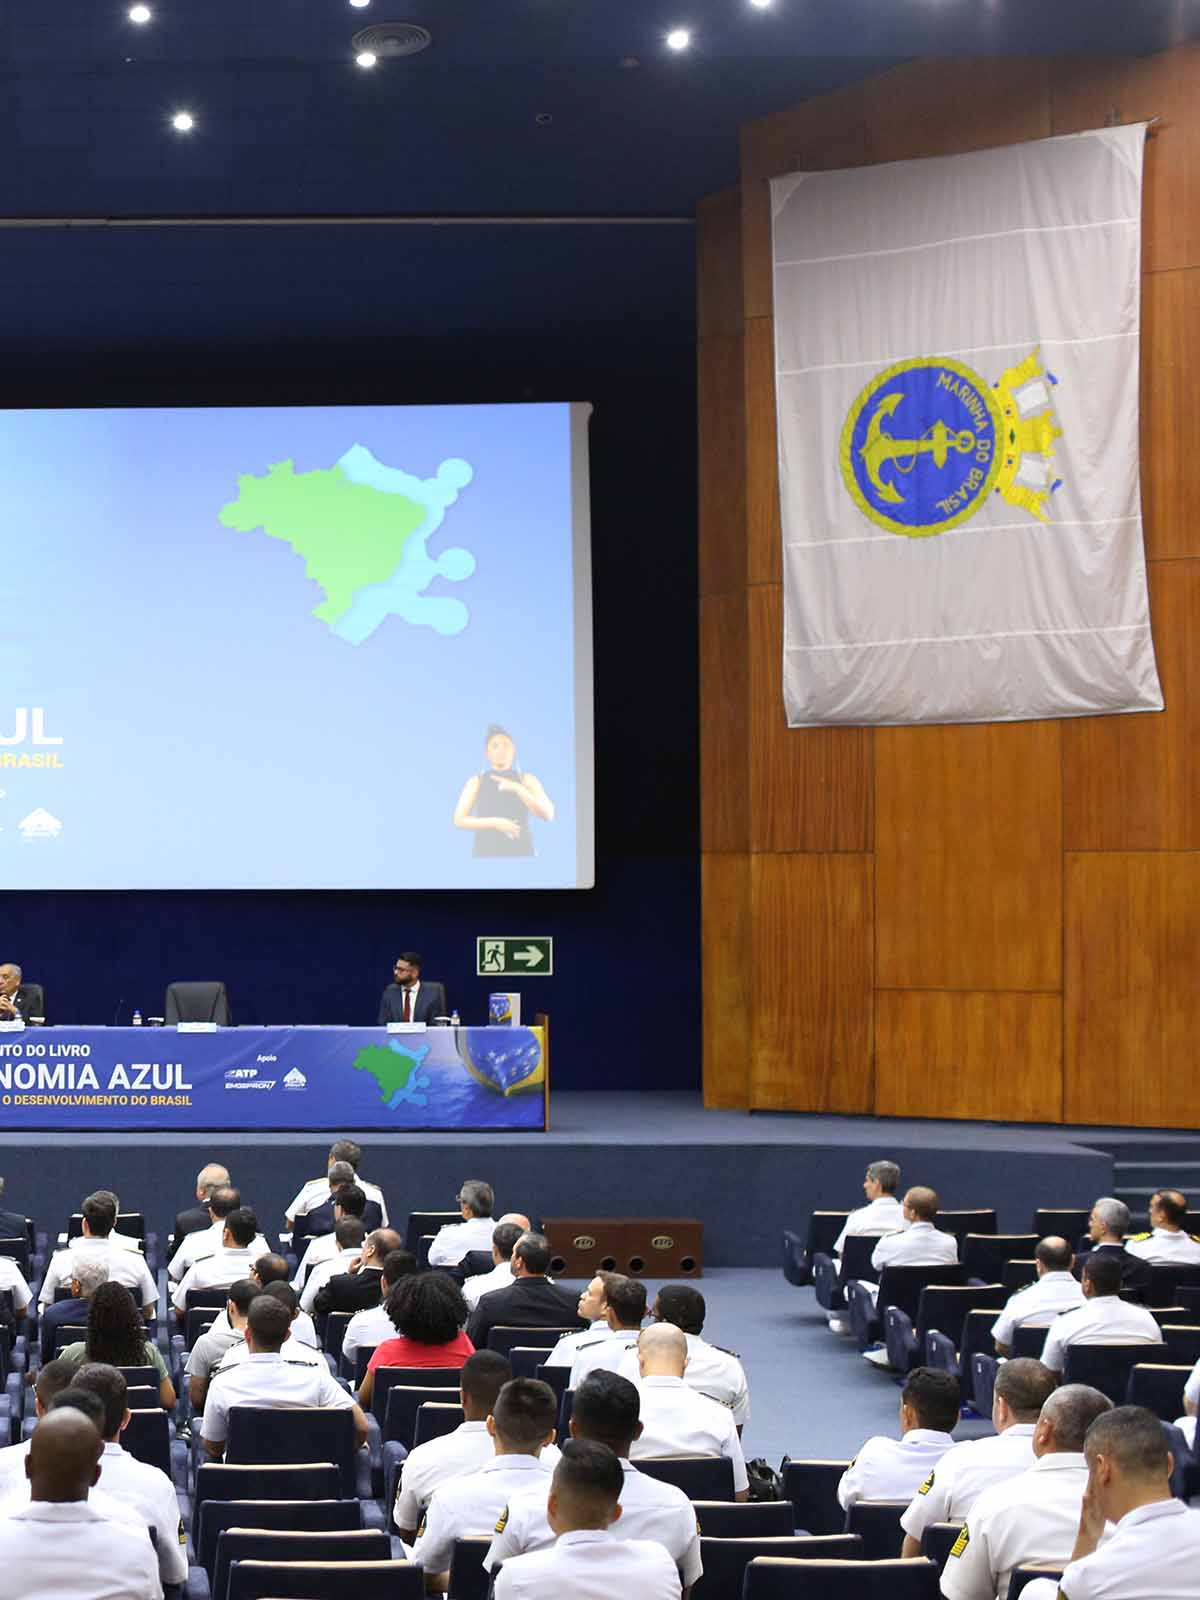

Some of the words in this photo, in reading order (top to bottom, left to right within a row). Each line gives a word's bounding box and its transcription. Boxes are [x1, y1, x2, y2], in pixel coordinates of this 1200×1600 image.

[935, 371, 990, 433] MARINHA
[975, 439, 992, 463] DO
[935, 467, 984, 514] BRASIL
[26, 1044, 46, 1056] DO
[49, 1044, 91, 1056] LIVRO
[107, 1063, 193, 1089] AZUL
[2, 1095, 11, 1105] O
[14, 1095, 128, 1106] DESENVOLVIMENTO
[130, 1095, 148, 1105] DO
[151, 1095, 193, 1105] BRASIL
